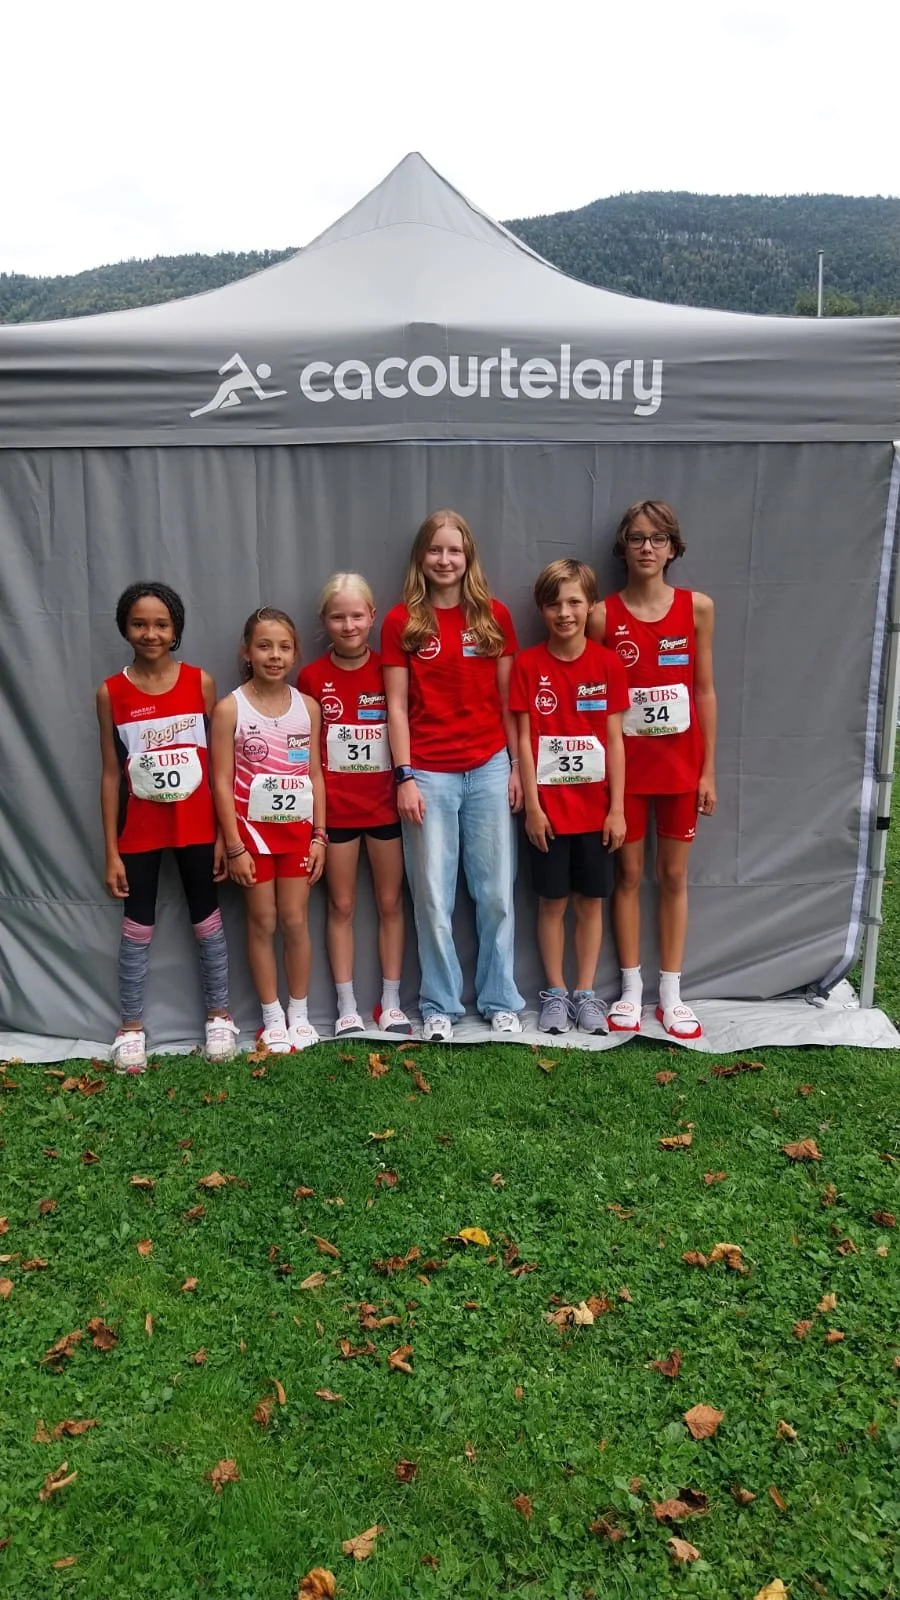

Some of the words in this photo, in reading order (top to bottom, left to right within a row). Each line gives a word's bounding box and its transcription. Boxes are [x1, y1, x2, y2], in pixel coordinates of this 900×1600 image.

[300, 343, 664, 417] cacourtelary
[649, 688, 679, 703] UBS
[643, 705, 670, 723] 34
[140, 715, 197, 749] Ragusa
[354, 728, 382, 740] UBS
[347, 744, 371, 761] 31
[566, 739, 594, 752] UBS
[157, 751, 190, 767] UBS
[558, 755, 584, 772] 33
[152, 770, 181, 789] 30
[280, 778, 305, 790] UBS
[271, 794, 296, 810] 32
